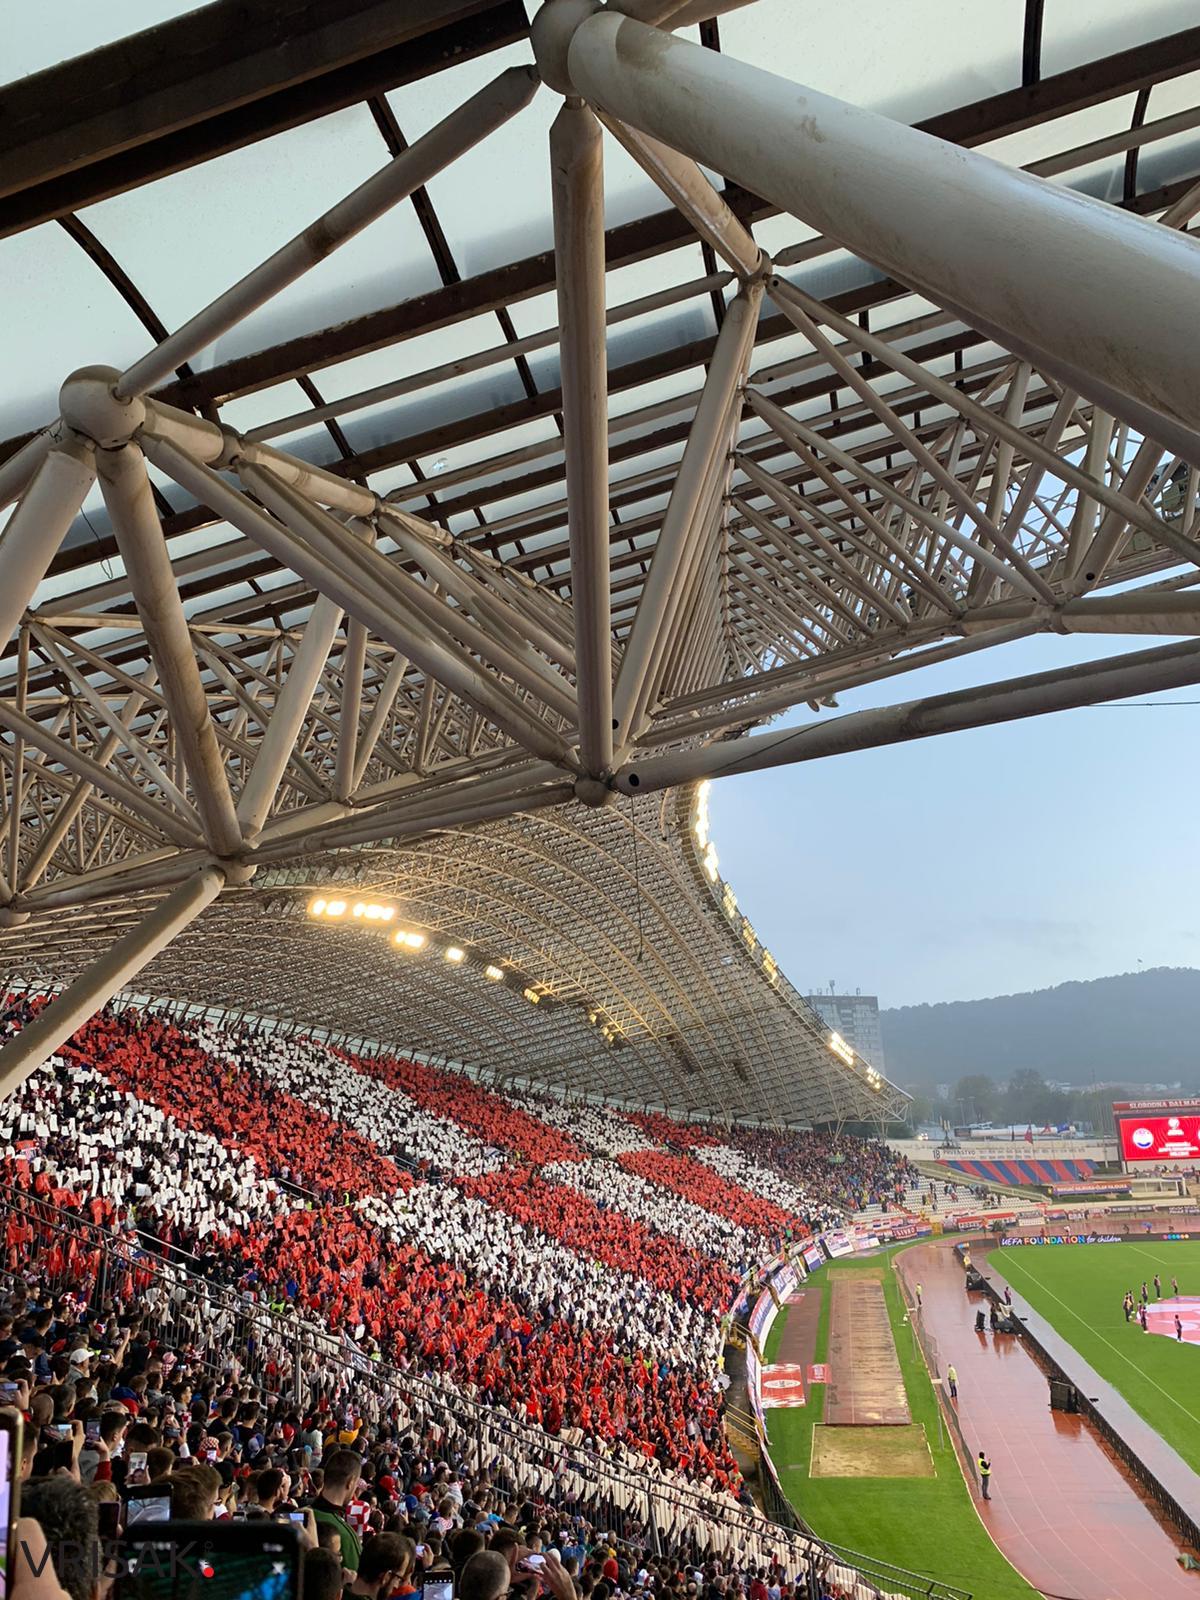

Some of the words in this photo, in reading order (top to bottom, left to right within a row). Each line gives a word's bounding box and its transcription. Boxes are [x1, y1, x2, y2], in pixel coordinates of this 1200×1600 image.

[1001, 1238, 1023, 1246] UEFA
[1024, 1234, 1085, 1246] FOUNDATION
[1086, 1235, 1097, 1244] for
[1097, 1233, 1122, 1243] children
